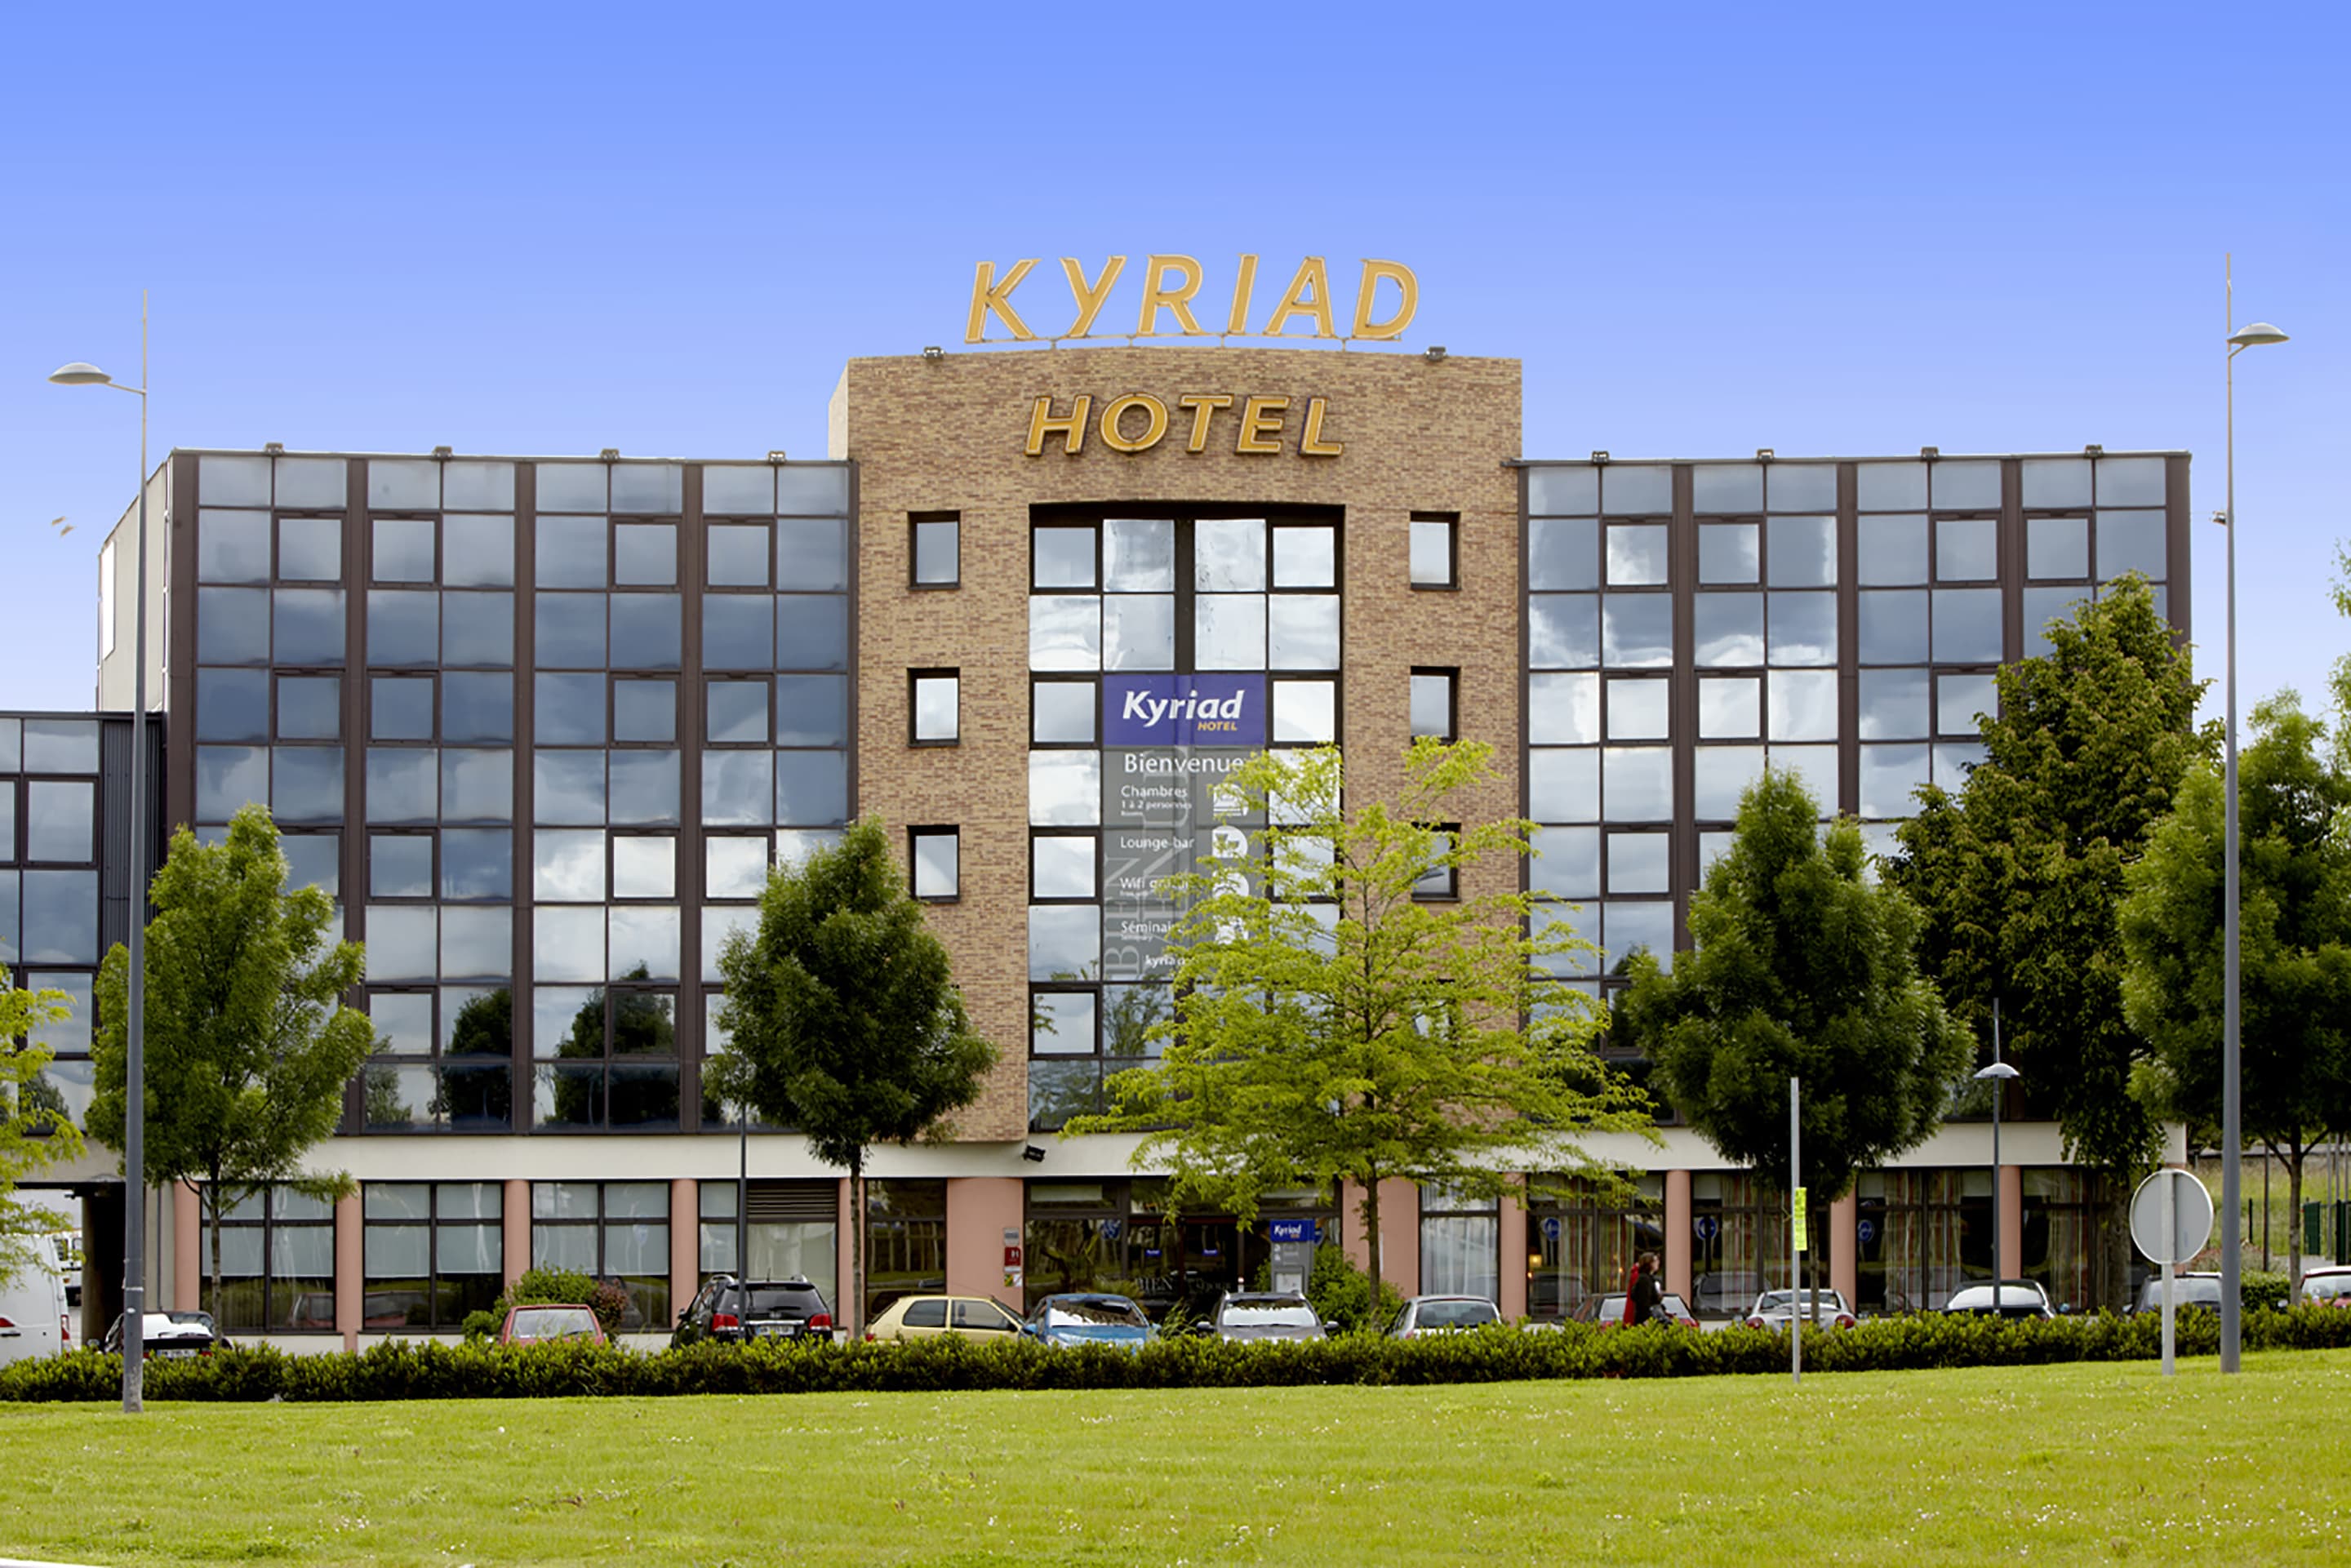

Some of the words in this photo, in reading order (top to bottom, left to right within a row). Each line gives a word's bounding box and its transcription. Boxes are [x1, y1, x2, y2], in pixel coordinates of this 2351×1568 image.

[964, 253, 1420, 343] KYRIAD
[1024, 392, 1344, 457] HOTEL
[1122, 690, 1245, 727] Kyriad
[1197, 722, 1238, 731] HOTEL
[1124, 753, 1245, 773] Bienvenue
[1121, 784, 1188, 797] Chambres
[1137, 800, 1144, 809] 2
[1120, 836, 1169, 852] Lounge
[1172, 836, 1195, 849] bar
[1119, 877, 1145, 889] Wifi
